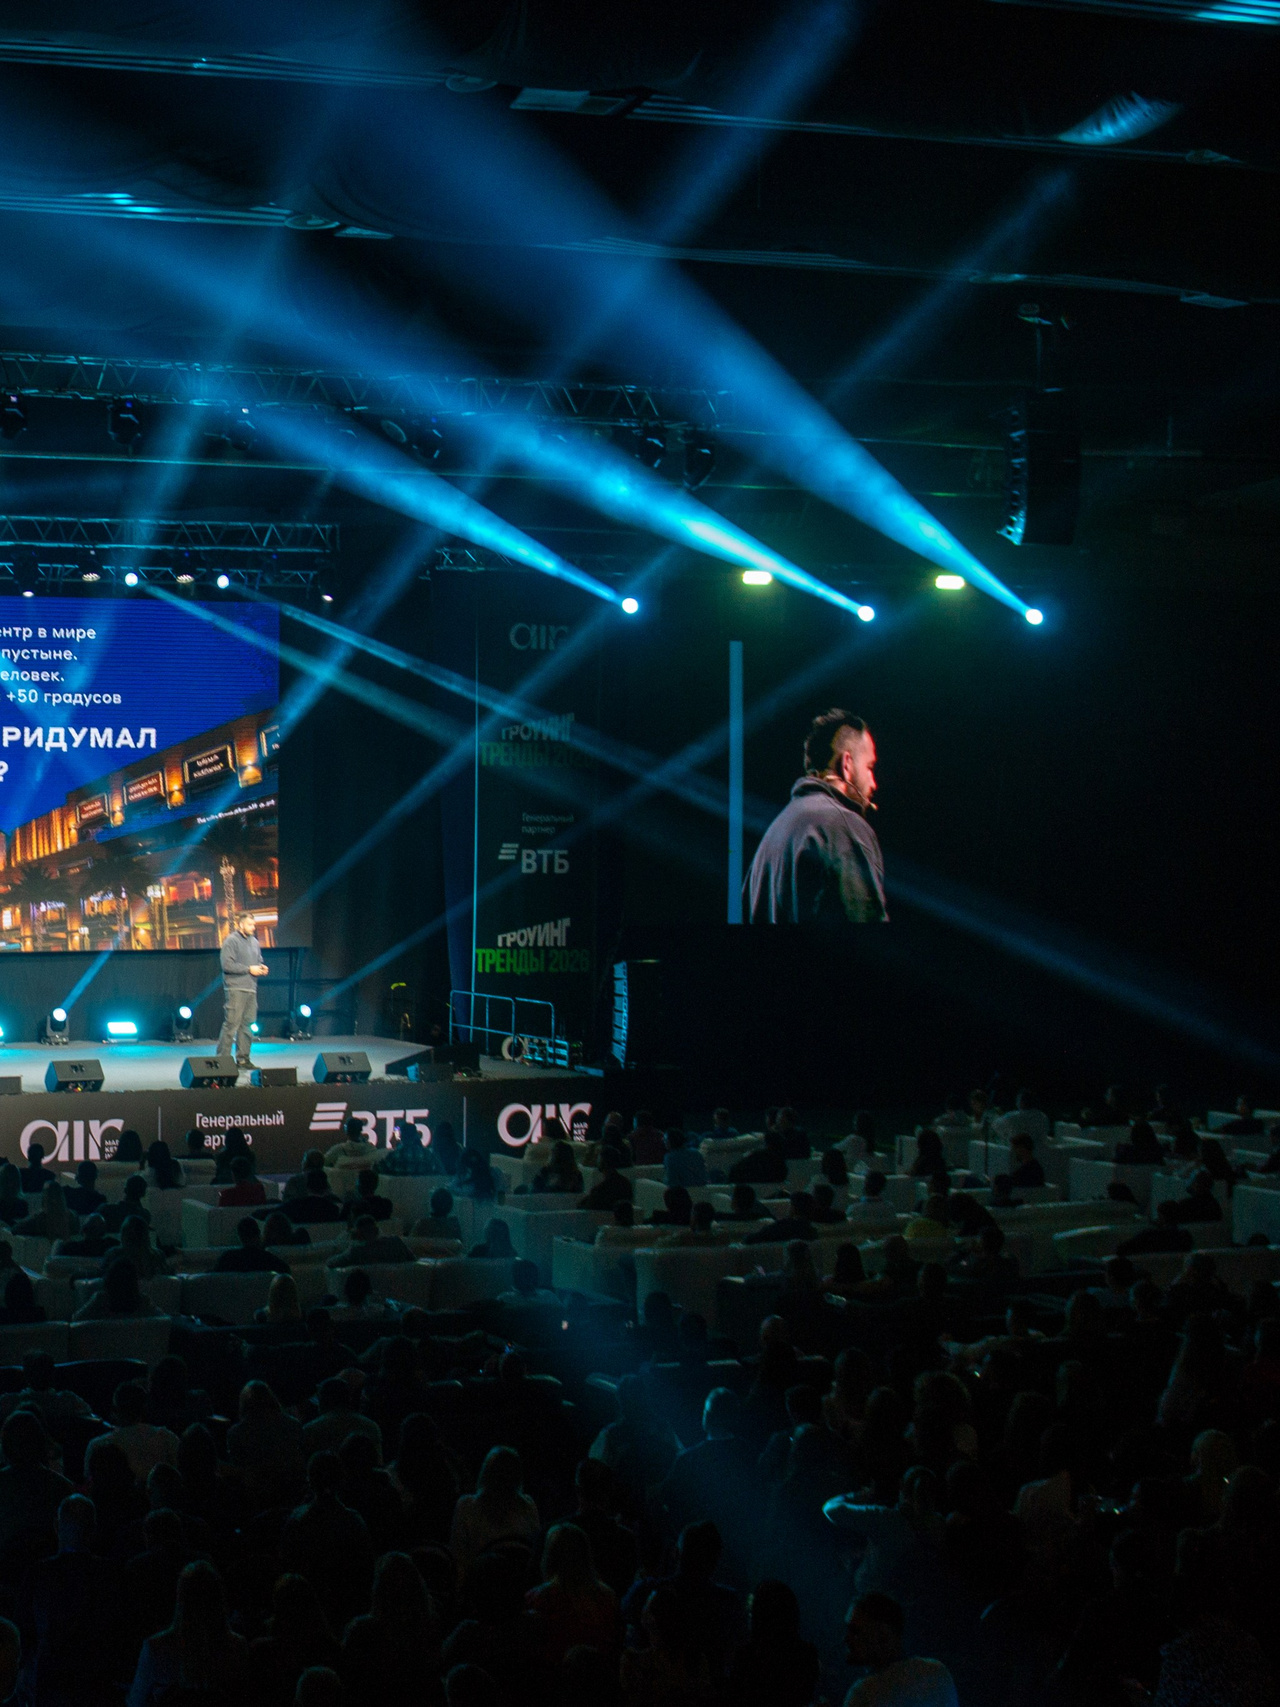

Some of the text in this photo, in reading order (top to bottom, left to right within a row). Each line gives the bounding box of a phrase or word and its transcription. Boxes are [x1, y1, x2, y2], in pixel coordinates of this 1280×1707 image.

[38, 627, 47, 638] в
[52, 627, 96, 642] мире
[1, 649, 78, 663] пустыне.
[6, 689, 38, 704] +50
[43, 692, 122, 707] градусов
[521, 849, 570, 874] ВТБ
[497, 917, 571, 947] ГРОУИНГ
[476, 948, 546, 975] ТРЕНДЫ
[196, 1110, 285, 1130] Генеральный
